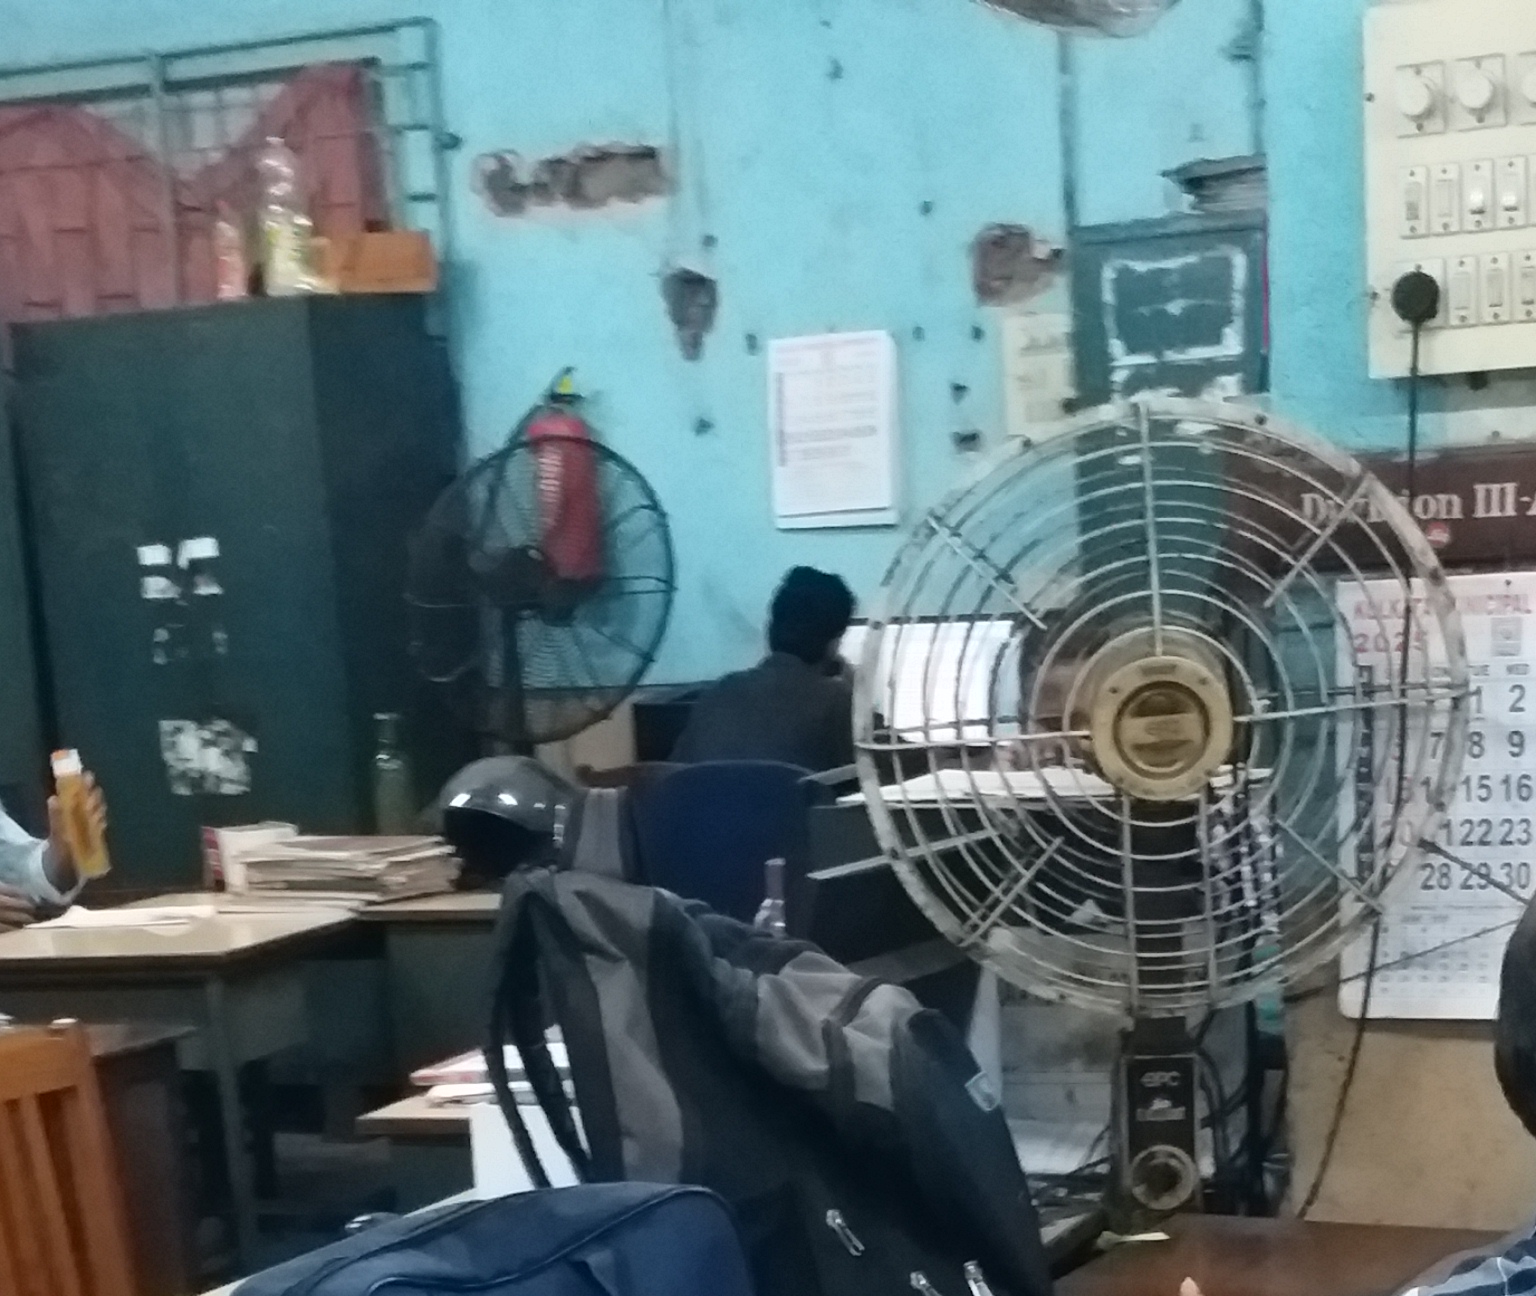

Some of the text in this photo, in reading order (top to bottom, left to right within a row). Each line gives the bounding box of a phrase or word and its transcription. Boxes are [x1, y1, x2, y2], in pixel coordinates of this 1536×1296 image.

[1300, 488, 1463, 525] Diviion
[1353, 597, 1432, 621] KOLKTA
[1508, 683, 1526, 713] 2
[1430, 732, 1445, 760] 7
[1467, 731, 1485, 759] 8
[1507, 729, 1525, 758] 9
[1461, 774, 1493, 803] 15
[1499, 773, 1533, 803] 16
[1460, 818, 1493, 847] 22
[1499, 817, 1533, 847] 23
[1420, 862, 1452, 891] 28
[1460, 862, 1492, 891] 29
[1500, 861, 1531, 891] 30
